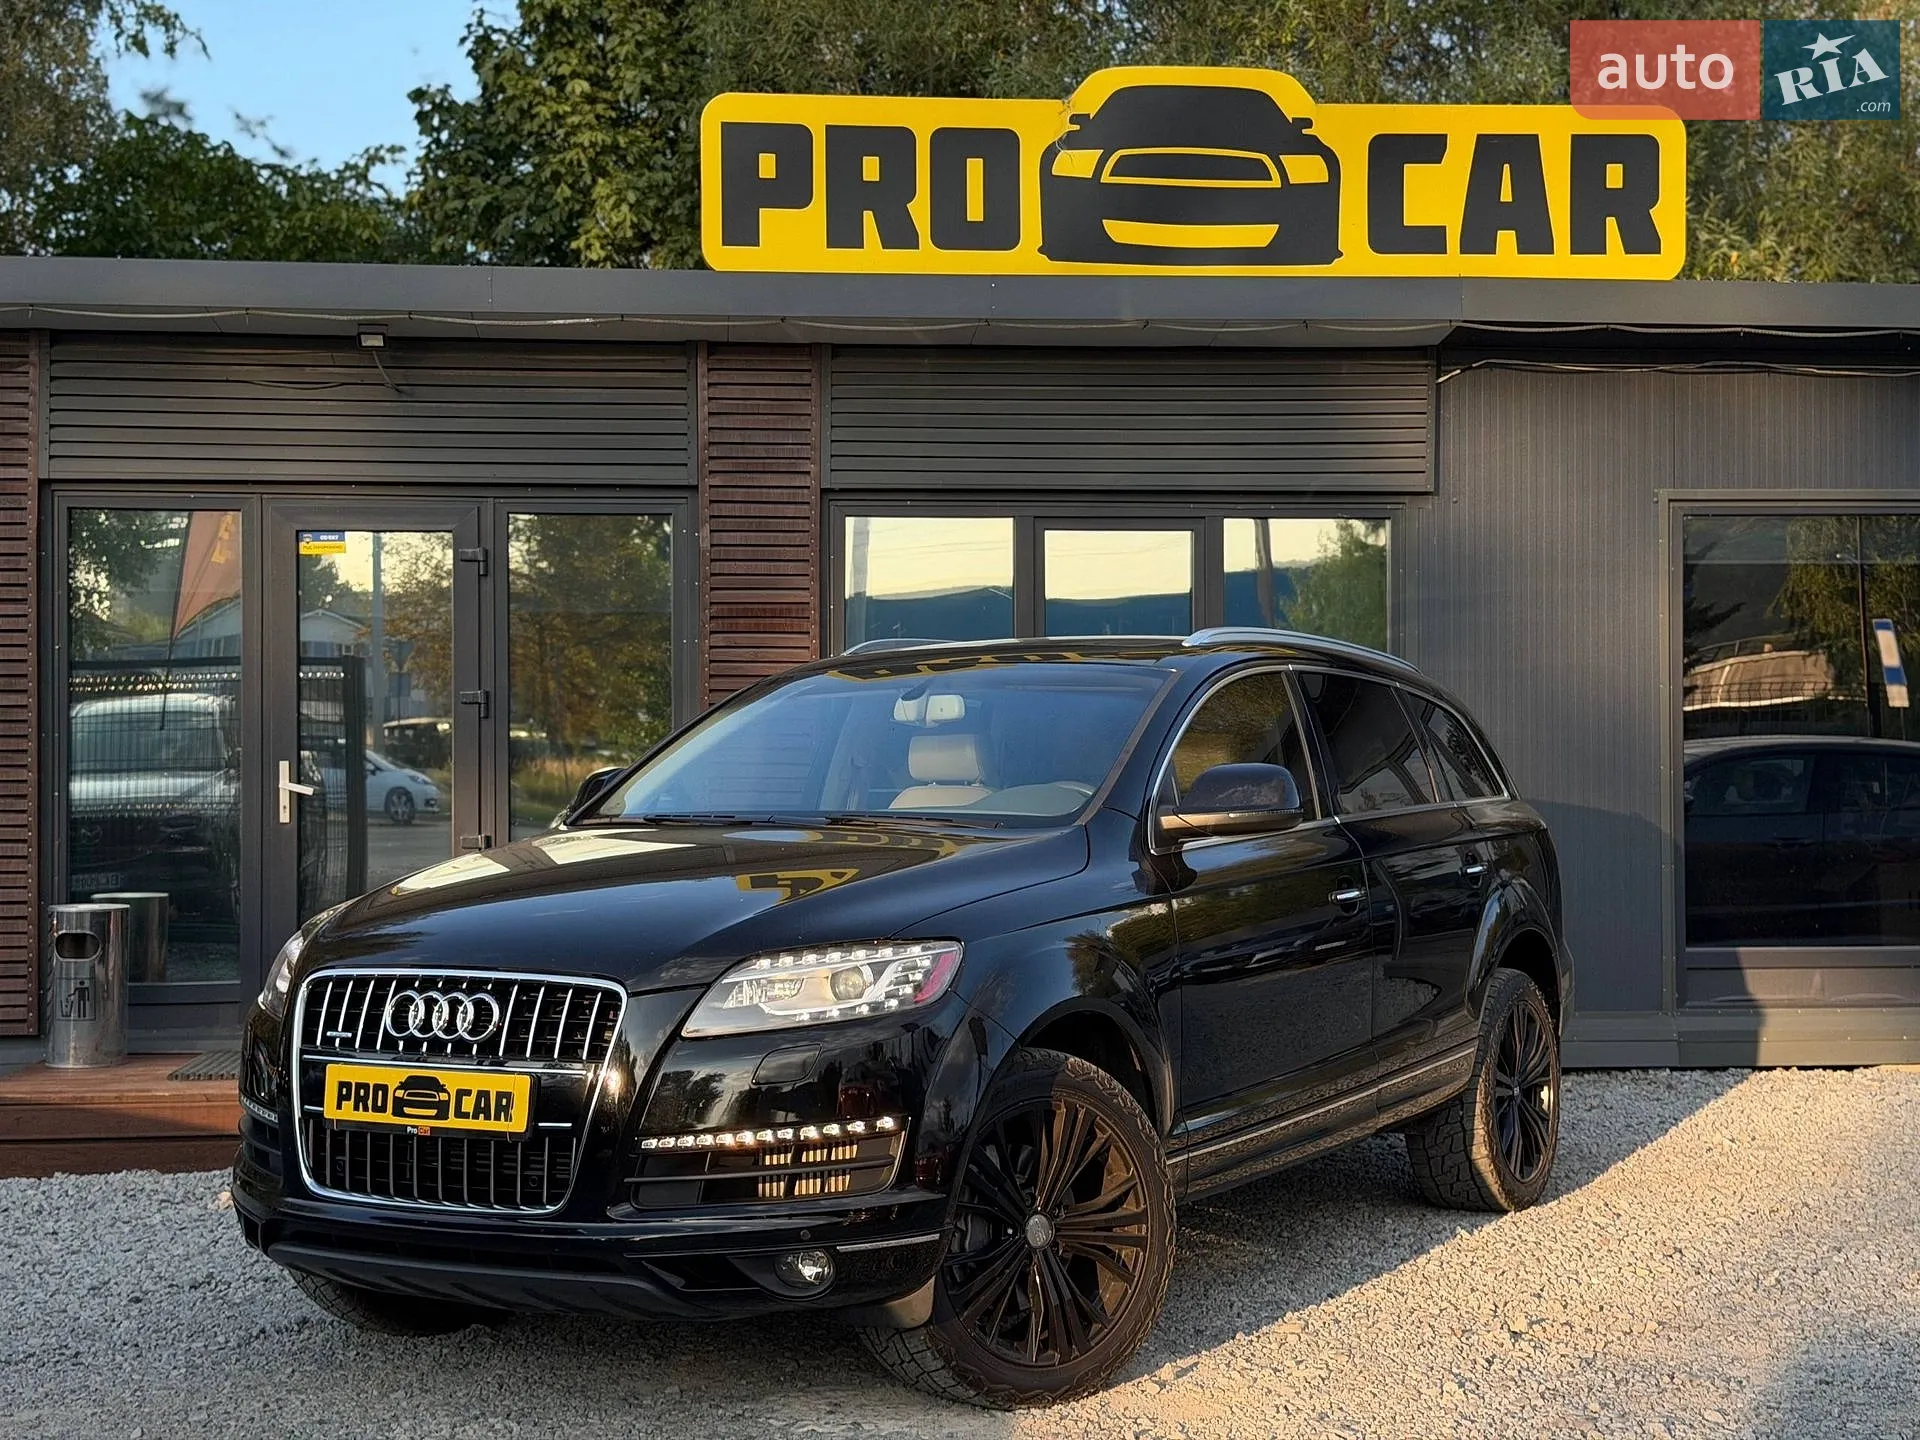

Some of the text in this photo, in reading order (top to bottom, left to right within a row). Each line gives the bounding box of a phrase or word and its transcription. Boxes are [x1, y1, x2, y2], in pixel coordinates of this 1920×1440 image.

[721, 122, 1662, 255] PRO CAR
[336, 1080, 515, 1122] PRO CAR
[407, 1126, 418, 1135] Pro
